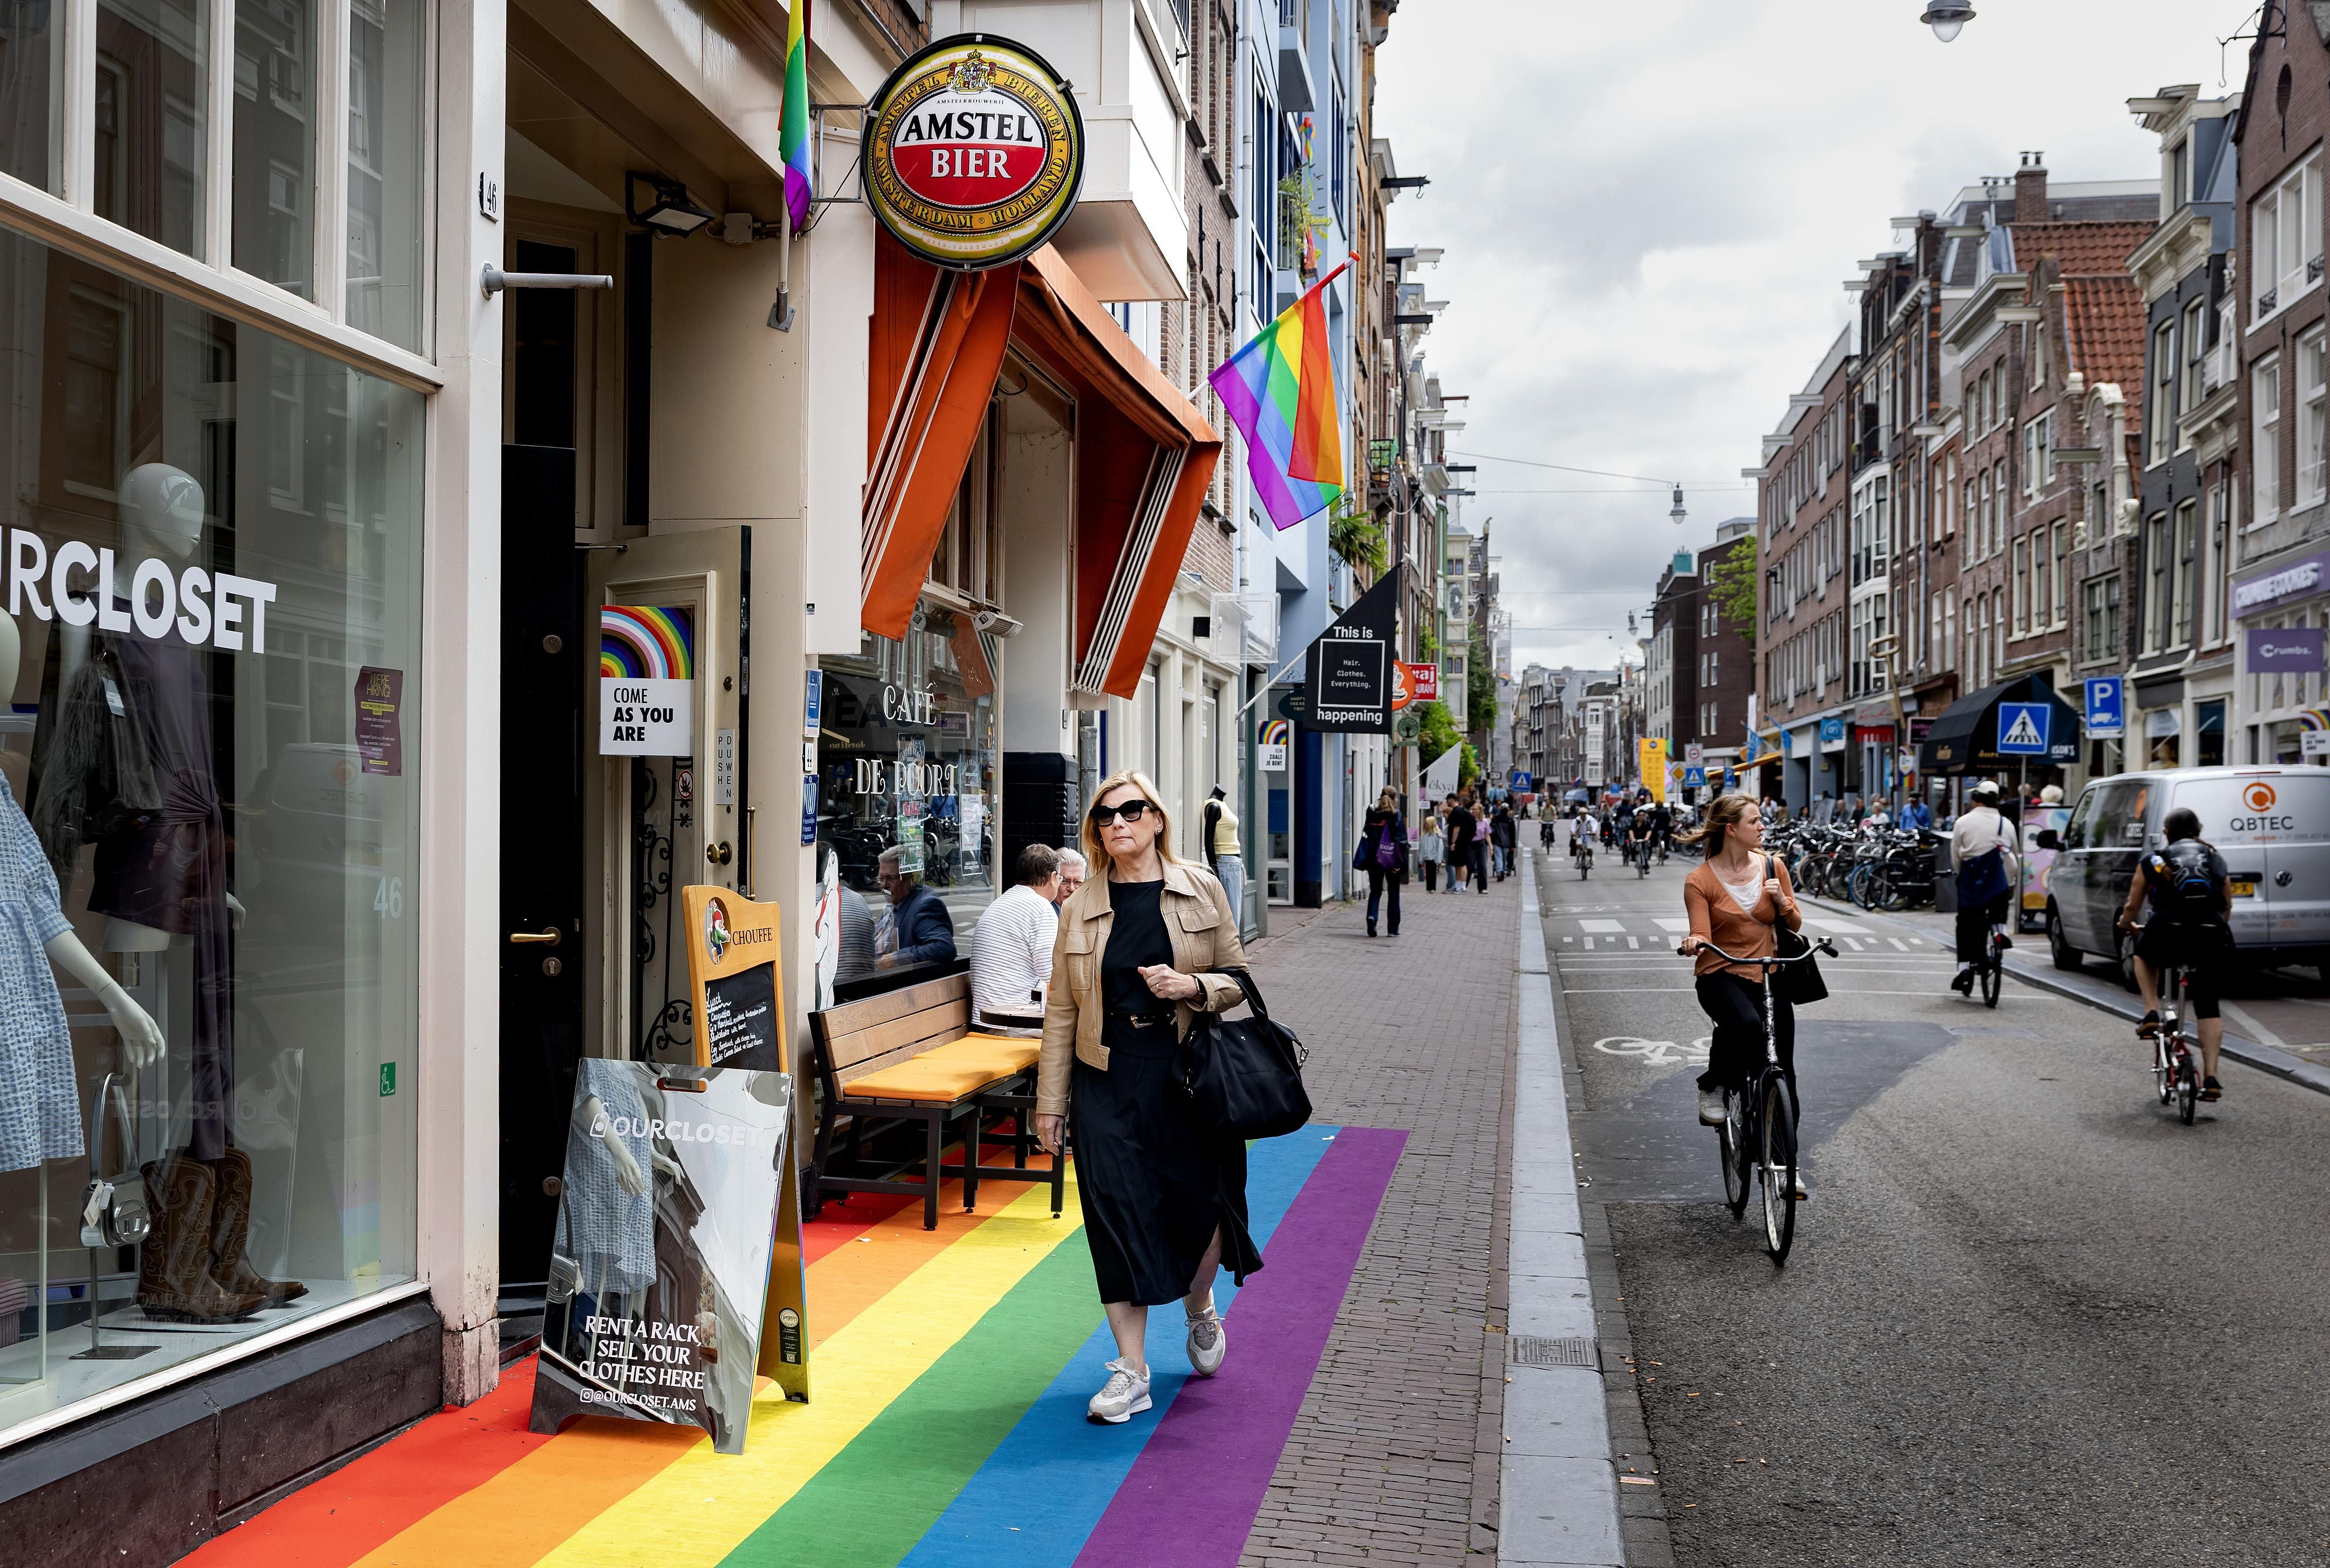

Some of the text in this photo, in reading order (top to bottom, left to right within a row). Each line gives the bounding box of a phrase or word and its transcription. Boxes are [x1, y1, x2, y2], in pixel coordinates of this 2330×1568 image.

[878, 75, 1065, 144] AMSTEL BIEREN
[901, 112, 1033, 143] AMSTEL
[930, 148, 1011, 179] BIER
[487, 181, 497, 213] 46
[877, 156, 972, 228] AMSTERDAM
[991, 158, 1064, 225] HOLLAND
[0, 525, 277, 654] RCLOSET
[1333, 626, 1373, 638] This is
[367, 684, 391, 698] HIRING!
[614, 687, 648, 704] COME
[1331, 680, 1371, 689] Everything.
[2094, 683, 2113, 707] P
[613, 706, 673, 723] AS YOU
[1317, 708, 1382, 725] happening
[613, 726, 645, 742] ARE
[807, 746, 812, 767] 44
[855, 759, 885, 794] DE
[893, 761, 958, 796] POORT
[2231, 815, 2293, 831] QBTEC
[373, 877, 402, 919] 46
[732, 927, 773, 946] CHOUFFE
[707, 987, 721, 1008] Lunch
[613, 1117, 765, 1148] OURCLOSET
[585, 1316, 702, 1348] RENT A RACK,
[597, 1340, 690, 1365] SELL YOUR
[579, 1360, 705, 1389] CLOTHES HERE
